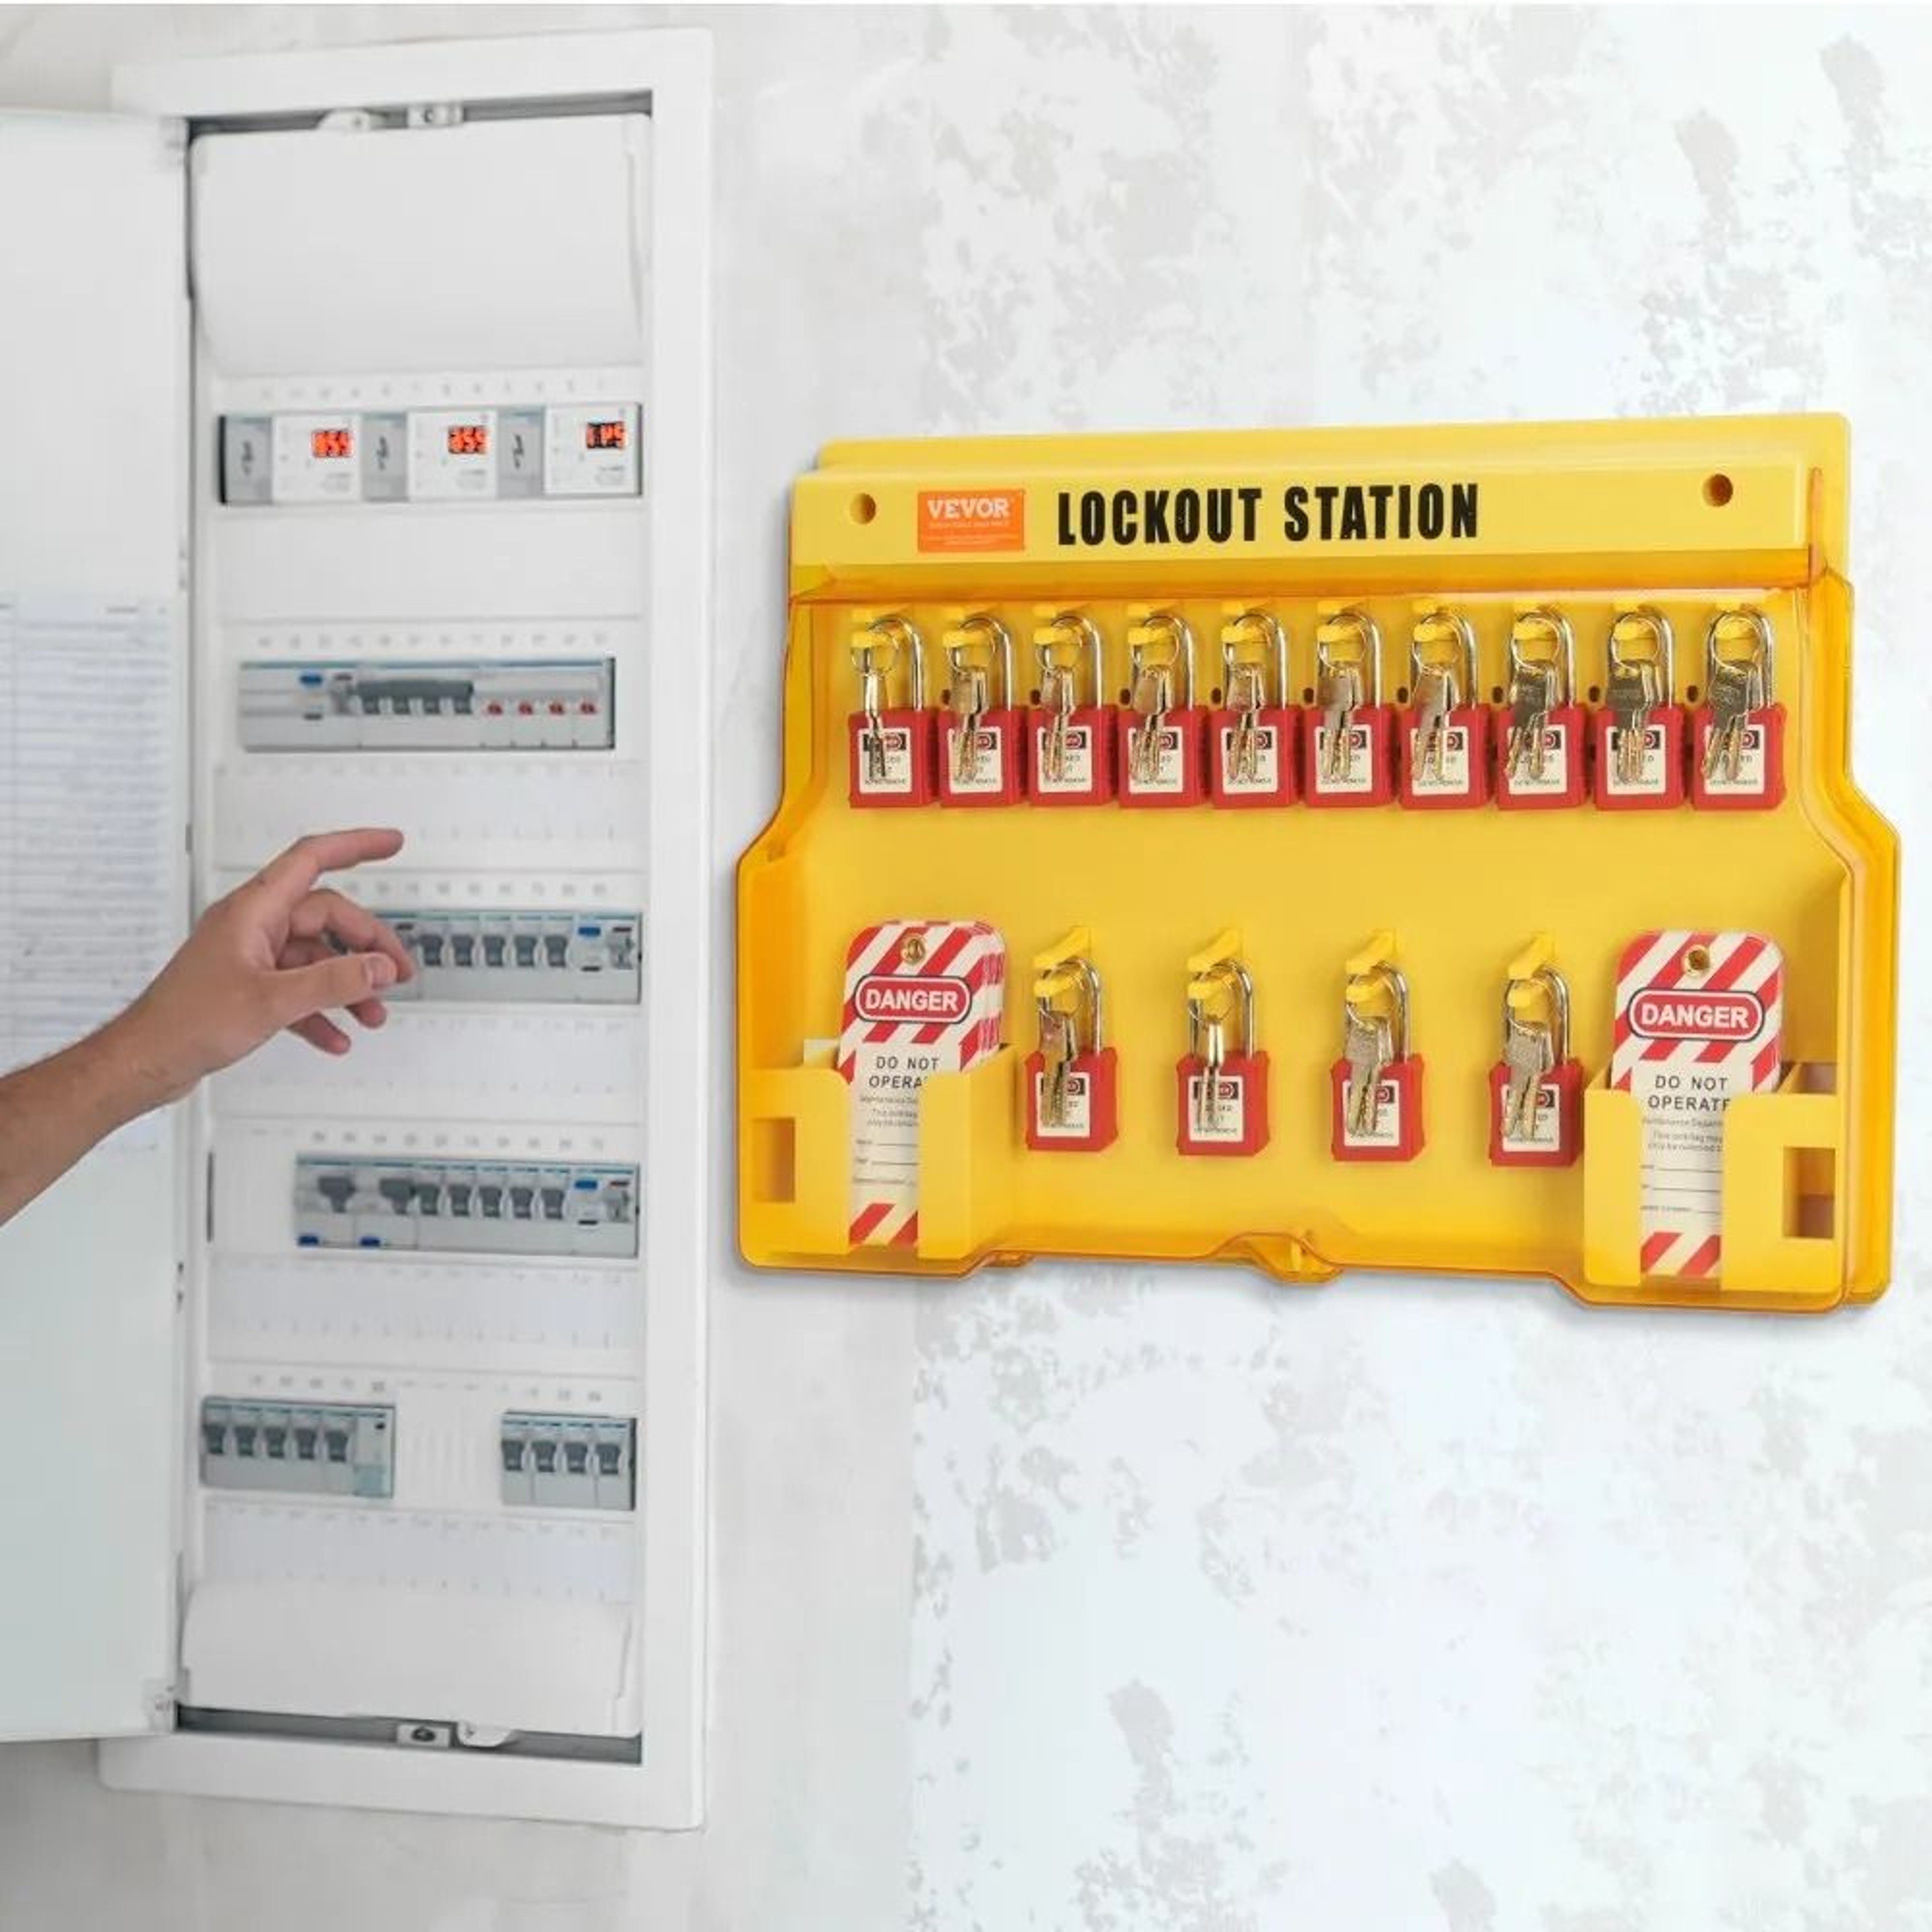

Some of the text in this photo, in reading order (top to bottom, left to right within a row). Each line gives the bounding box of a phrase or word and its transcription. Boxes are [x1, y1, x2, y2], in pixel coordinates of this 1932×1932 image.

[927, 497, 1009, 519] VEVOR
[1058, 483, 1479, 545] LOCKOUT STATION
[865, 989, 958, 1011] DANGER
[1641, 1003, 1749, 1028] DANGER
[876, 1056, 939, 1071] DO NOT
[868, 1075, 928, 1088] OPERA
[1655, 1075, 1728, 1091] DO NOT
